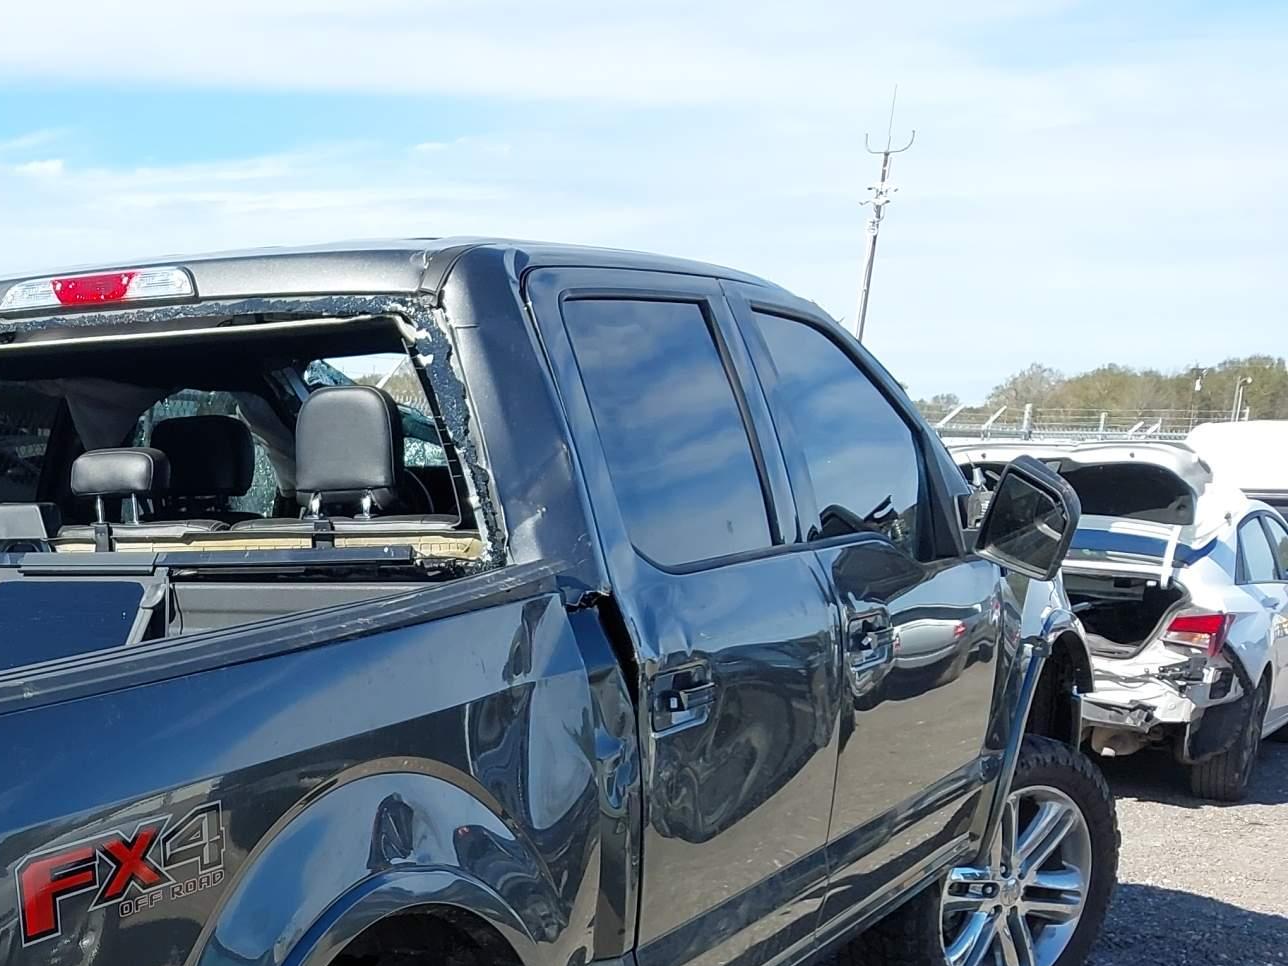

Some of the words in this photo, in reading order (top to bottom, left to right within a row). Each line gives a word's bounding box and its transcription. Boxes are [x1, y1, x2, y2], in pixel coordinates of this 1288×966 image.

[15, 800, 226, 948] FX4
[119, 889, 164, 918] OFF
[170, 869, 225, 900] ROAD
